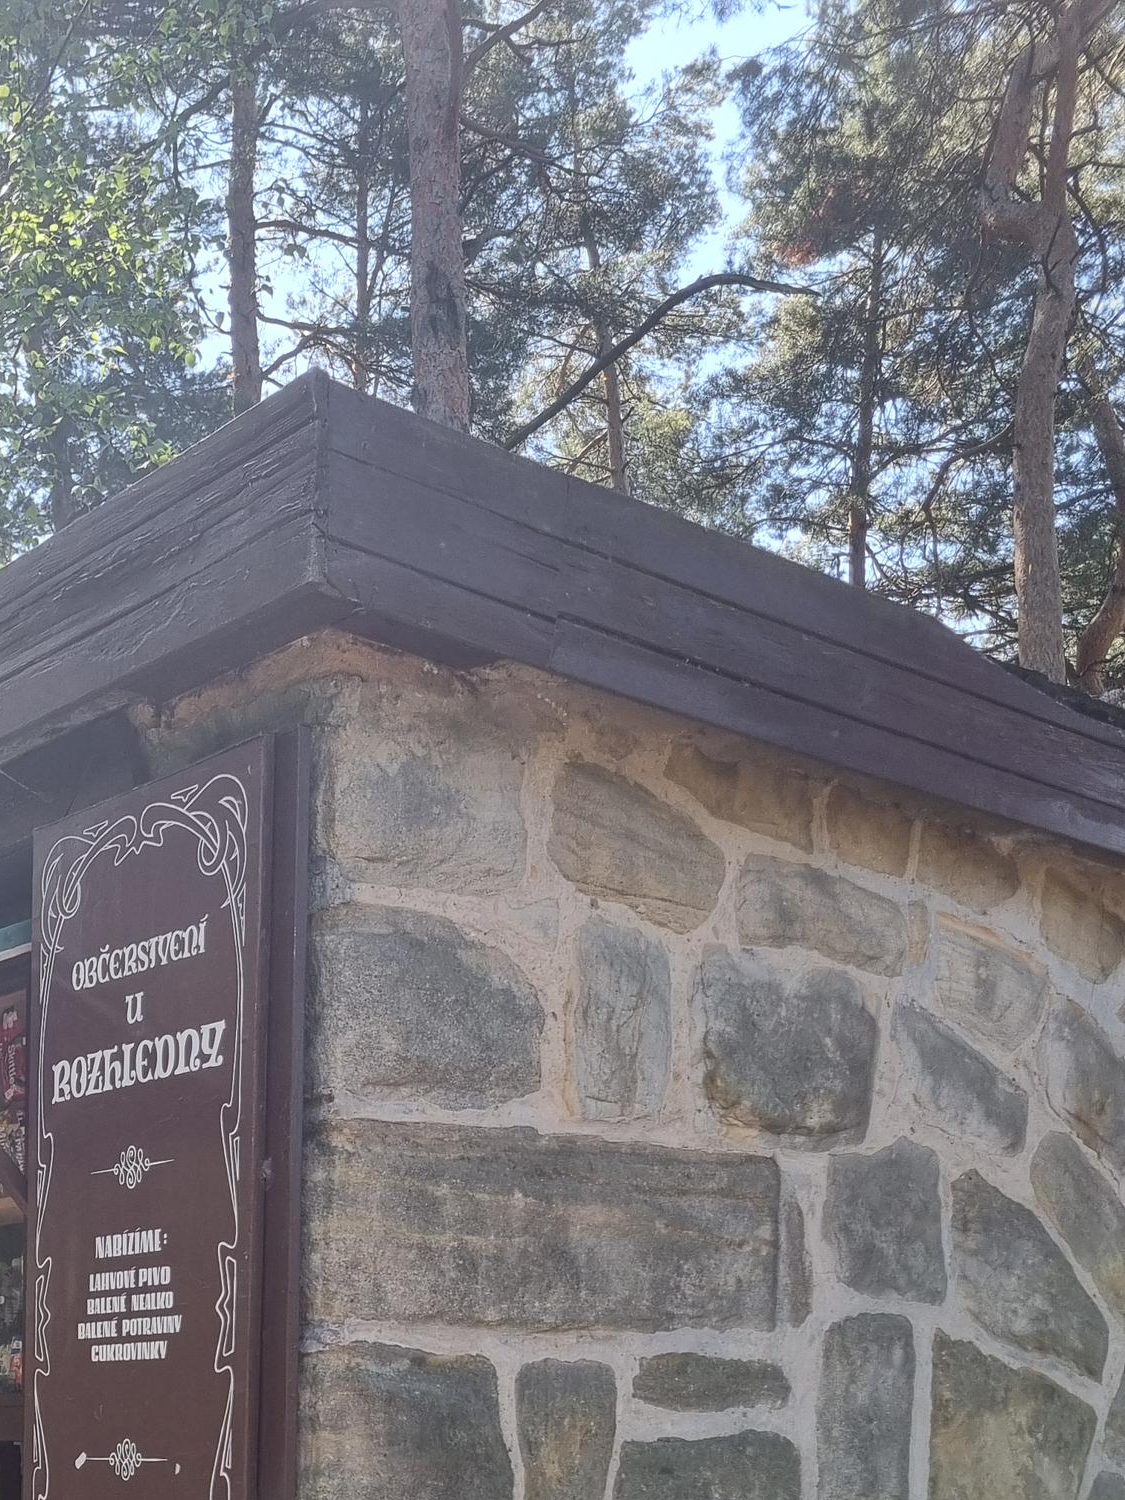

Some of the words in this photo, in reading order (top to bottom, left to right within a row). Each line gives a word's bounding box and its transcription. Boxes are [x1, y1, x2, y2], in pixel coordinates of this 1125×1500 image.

[72, 914, 209, 991] OBČERSTVENÍ
[125, 992, 144, 1025] U
[52, 1020, 226, 1104] ROZHLEDNY
[89, 1266, 136, 1292] LAHVOVÉ
[138, 1265, 171, 1288] PIVO
[86, 1292, 127, 1315] BALENÉ
[131, 1291, 174, 1312] NEALKO
[77, 1316, 119, 1340] BALENÉ
[122, 1314, 182, 1337] POTRAVINY
[91, 1340, 168, 1362] CUKROVINKY
